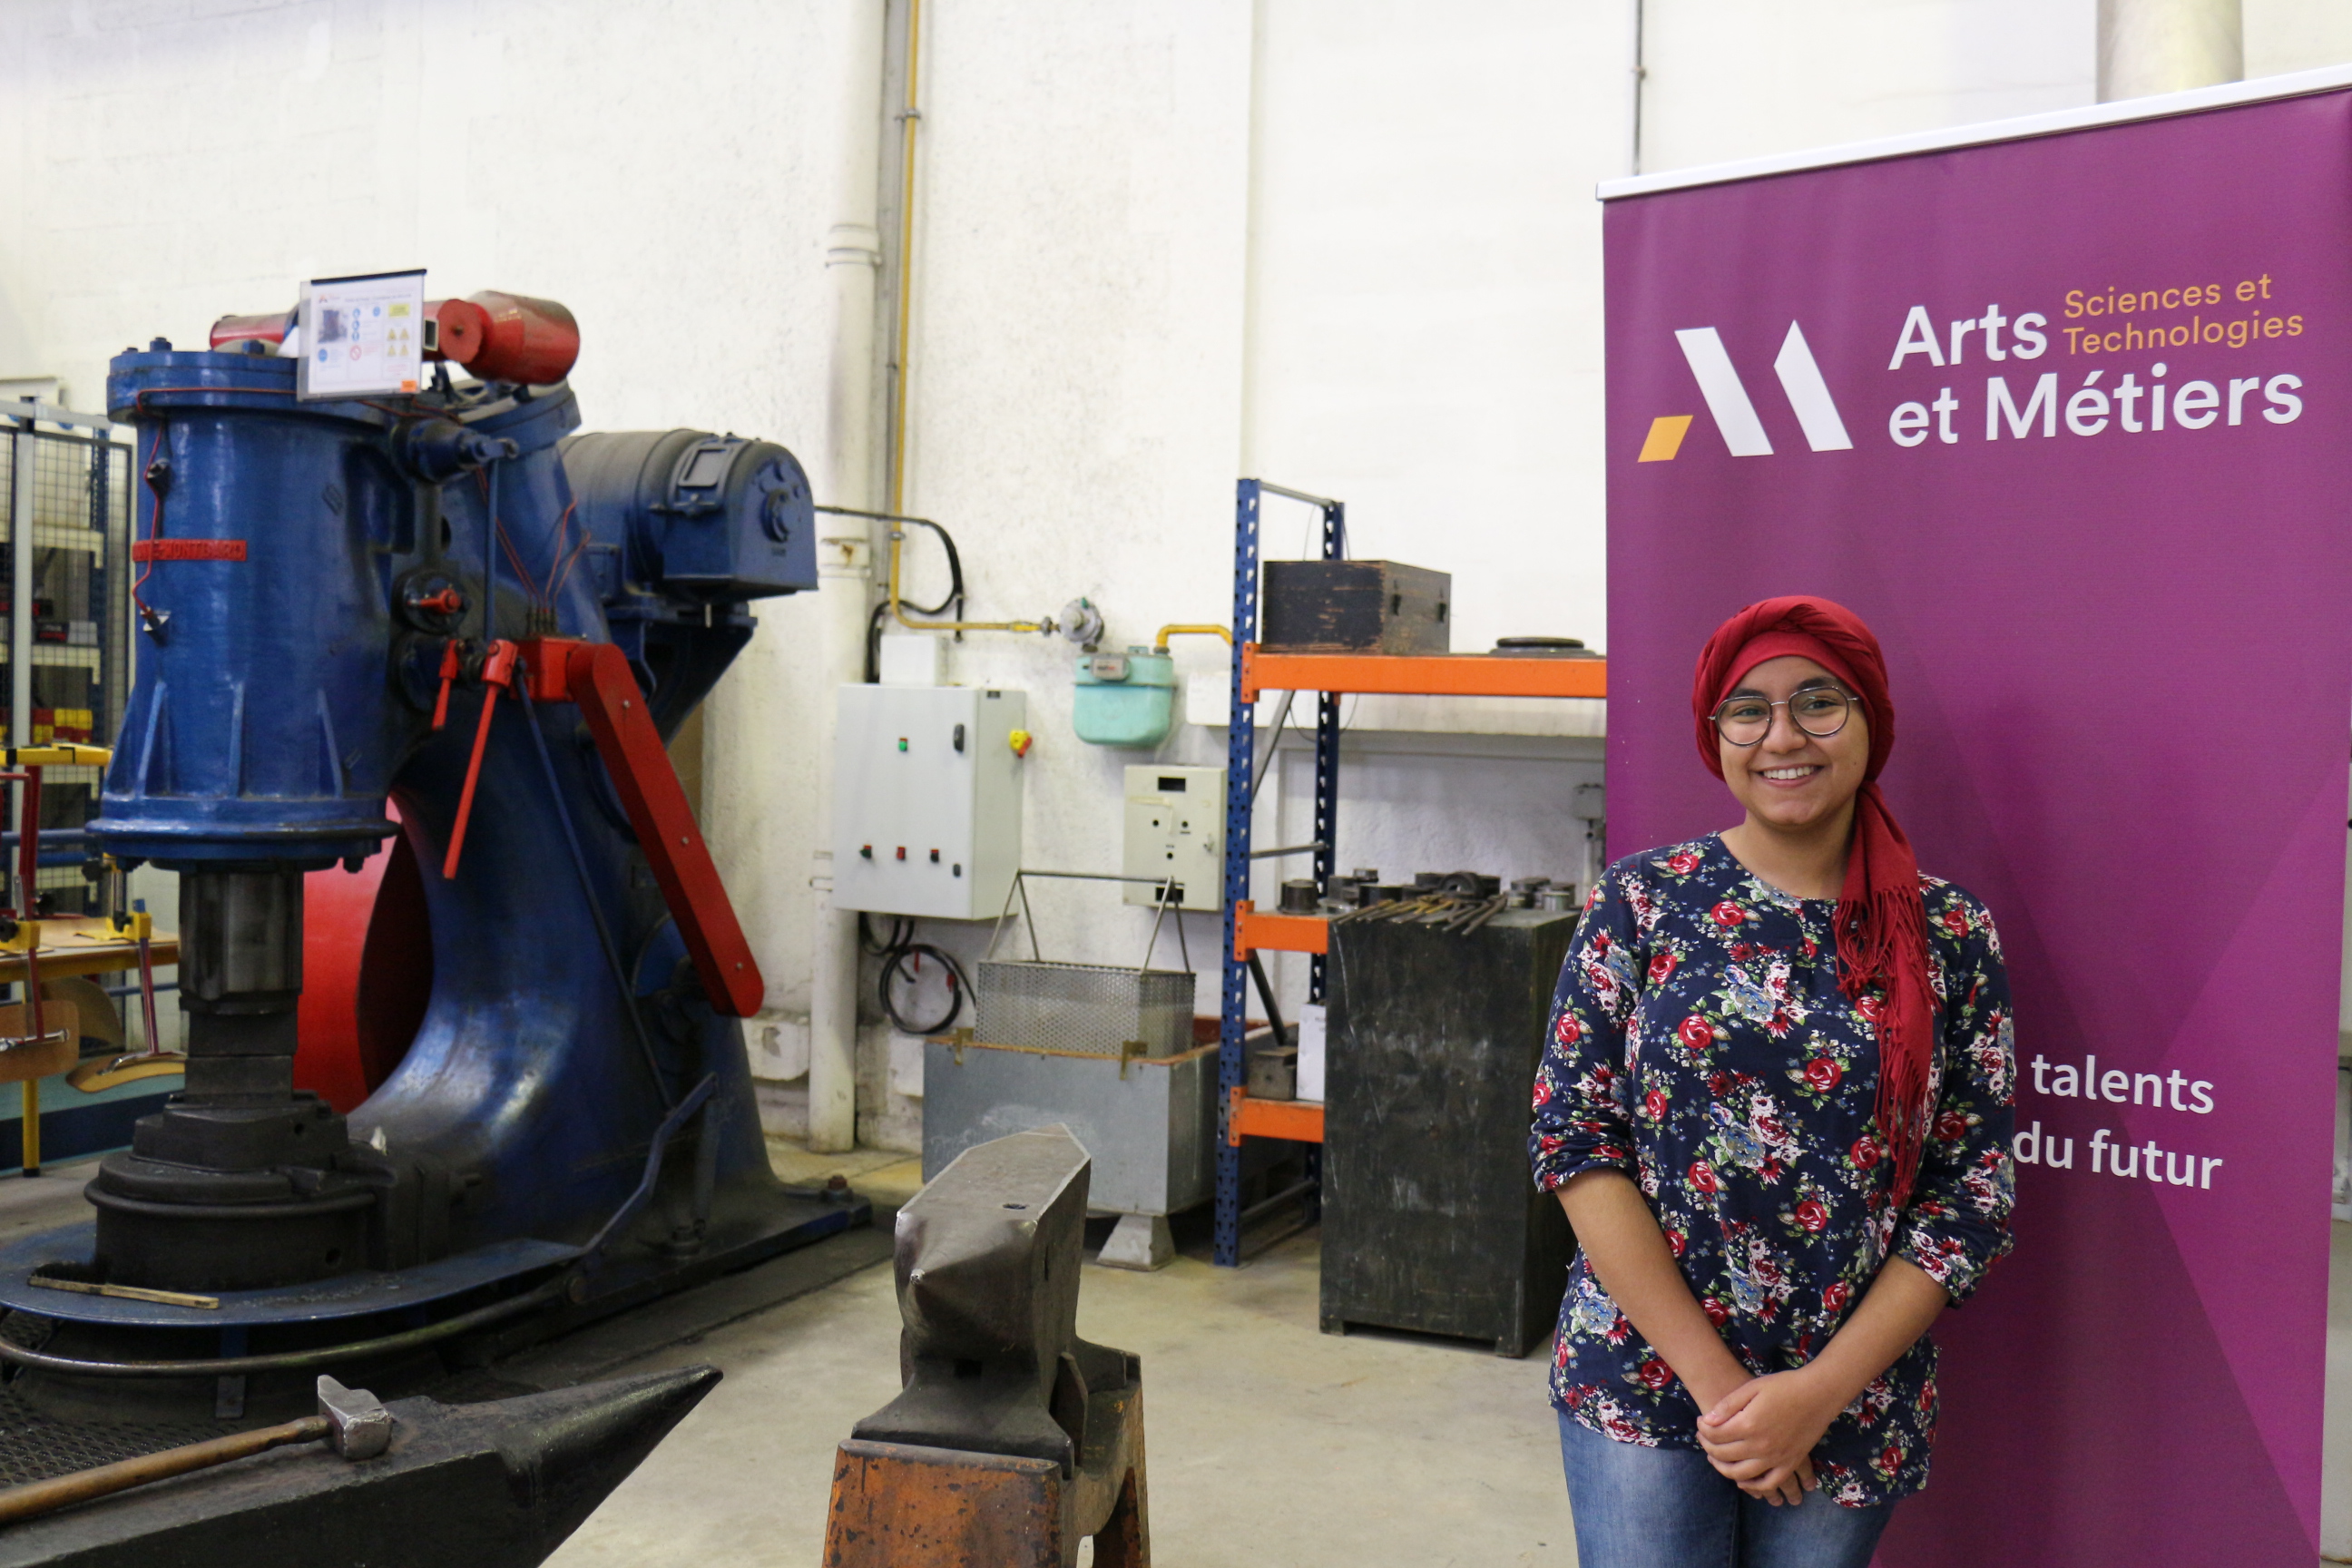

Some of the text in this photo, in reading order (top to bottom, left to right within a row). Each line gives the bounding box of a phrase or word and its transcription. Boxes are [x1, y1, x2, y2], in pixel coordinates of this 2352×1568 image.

[2063, 273, 2272, 318] Sciences et
[1888, 304, 2048, 369] Arts
[2062, 309, 2304, 356] Technologies
[1888, 363, 2303, 447] et Métiers
[2031, 1054, 2214, 1114] talents
[2014, 1121, 2223, 1190] du futur
